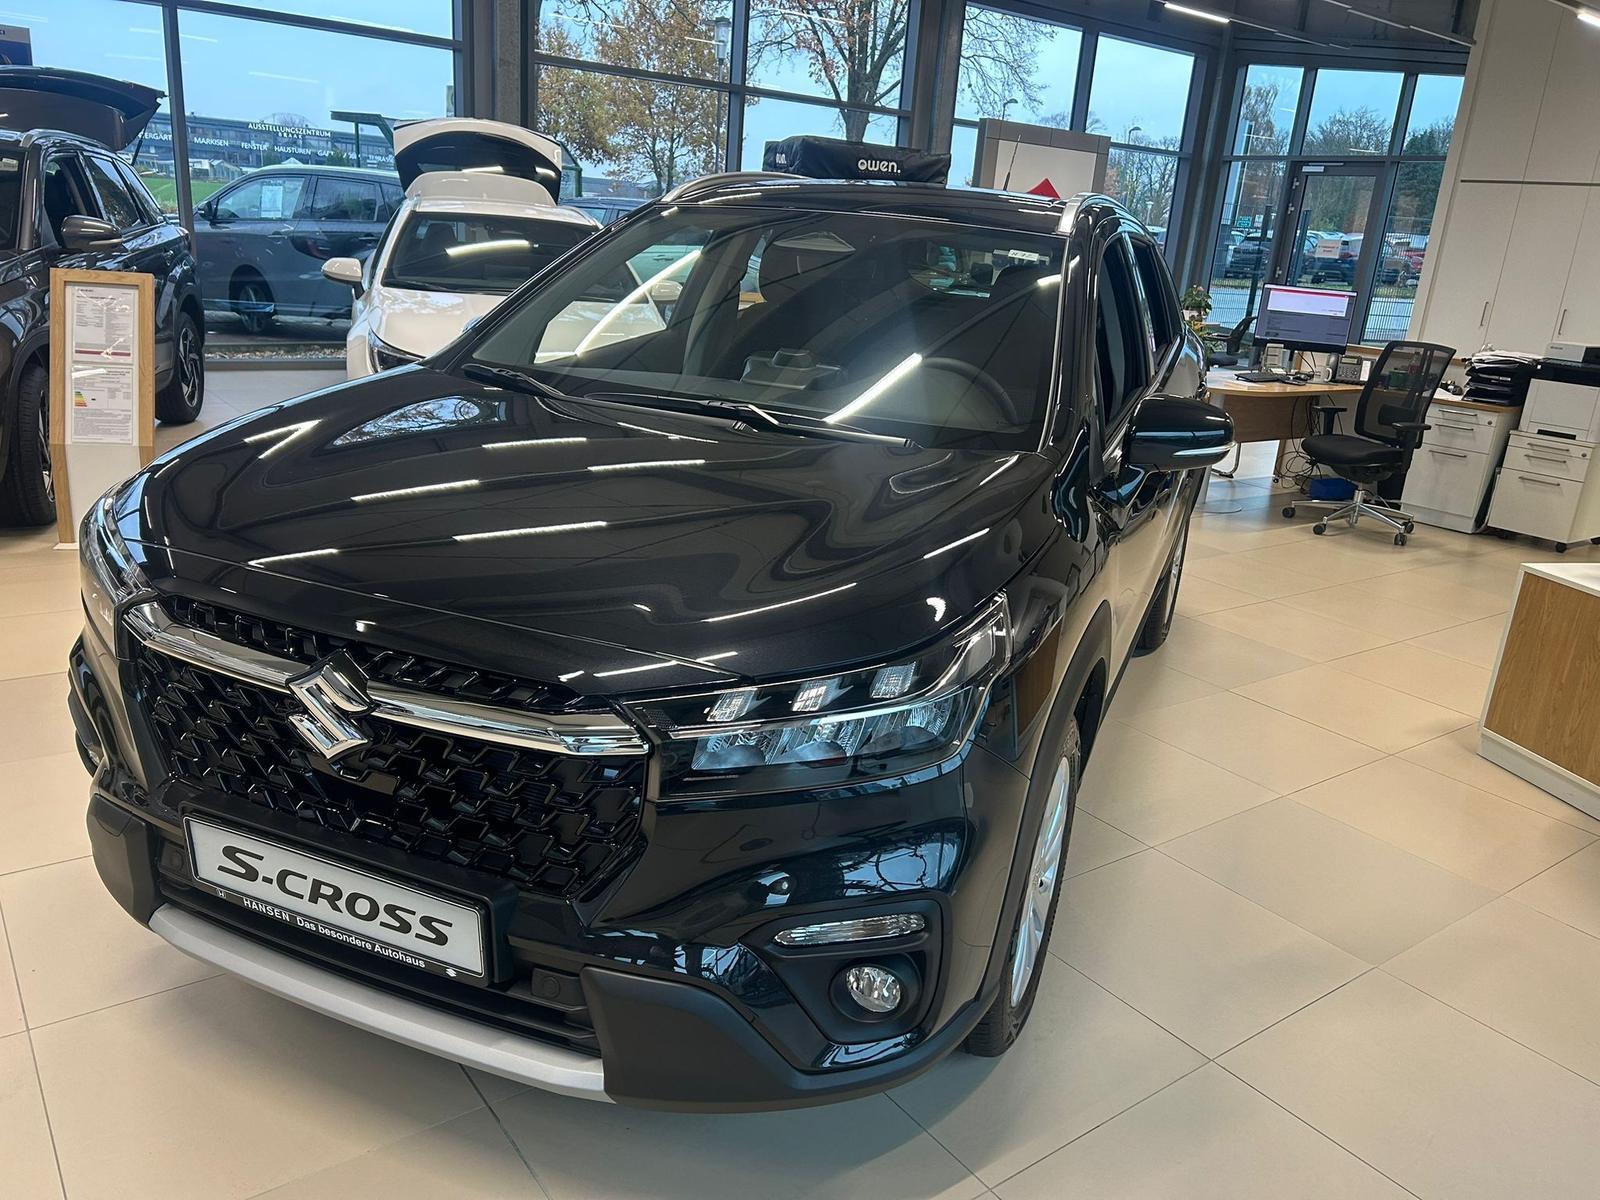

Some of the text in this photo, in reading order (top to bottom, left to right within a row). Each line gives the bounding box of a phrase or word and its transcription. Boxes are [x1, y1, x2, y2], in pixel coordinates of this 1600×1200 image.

[248, 123, 331, 137] AUSSTELLUNGSZENTRUM
[194, 137, 229, 147] MARKISEN
[858, 159, 901, 174] owen.
[217, 845, 453, 947] S-CROSS
[243, 898, 426, 968] HANSEN Das besondere Autohaus
